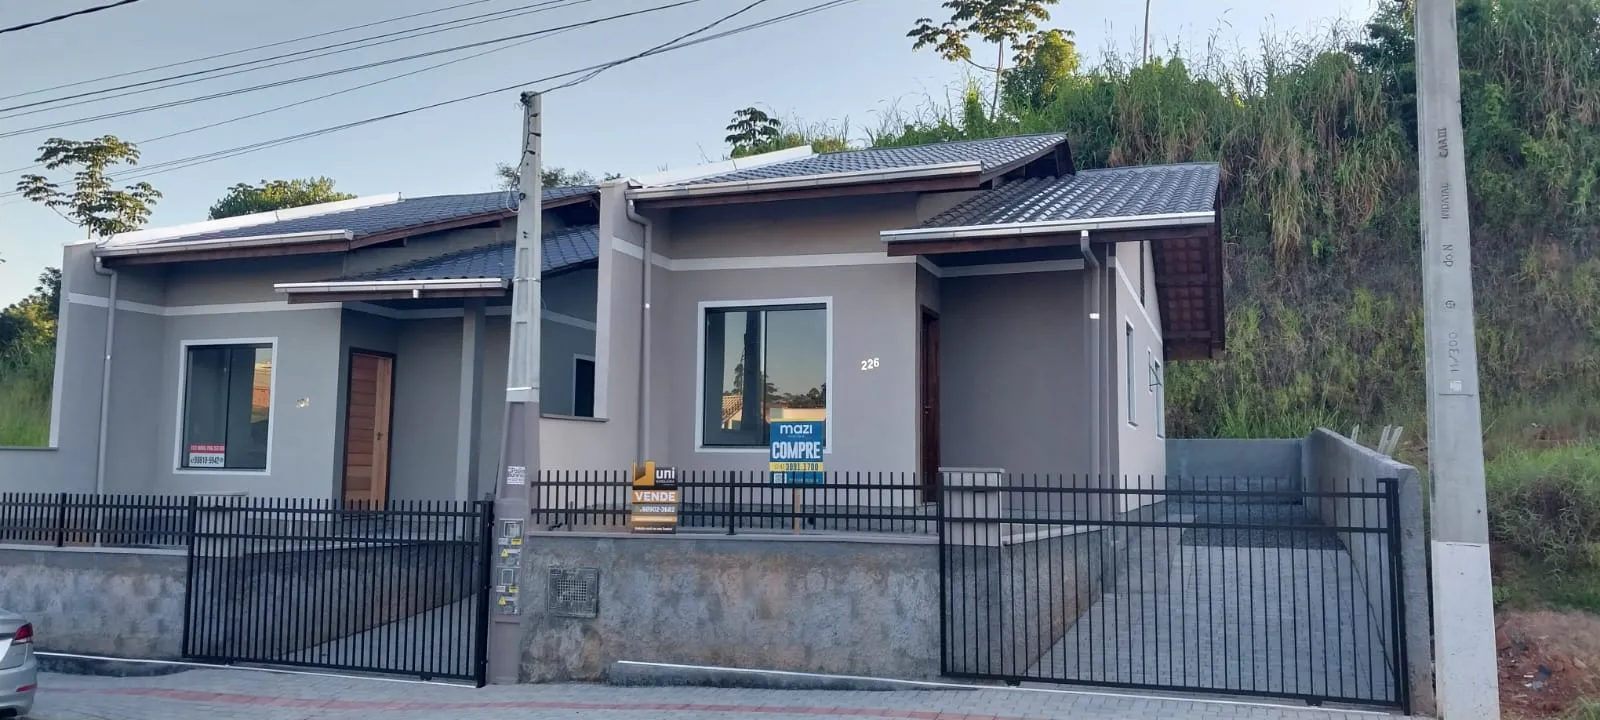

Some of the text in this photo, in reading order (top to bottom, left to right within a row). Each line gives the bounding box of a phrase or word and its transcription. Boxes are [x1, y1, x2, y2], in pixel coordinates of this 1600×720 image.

[861, 357, 880, 370] 226
[780, 424, 813, 434] mazi
[772, 441, 821, 459] COMPRE
[656, 467, 675, 479] uni
[635, 491, 676, 502] VENDE
